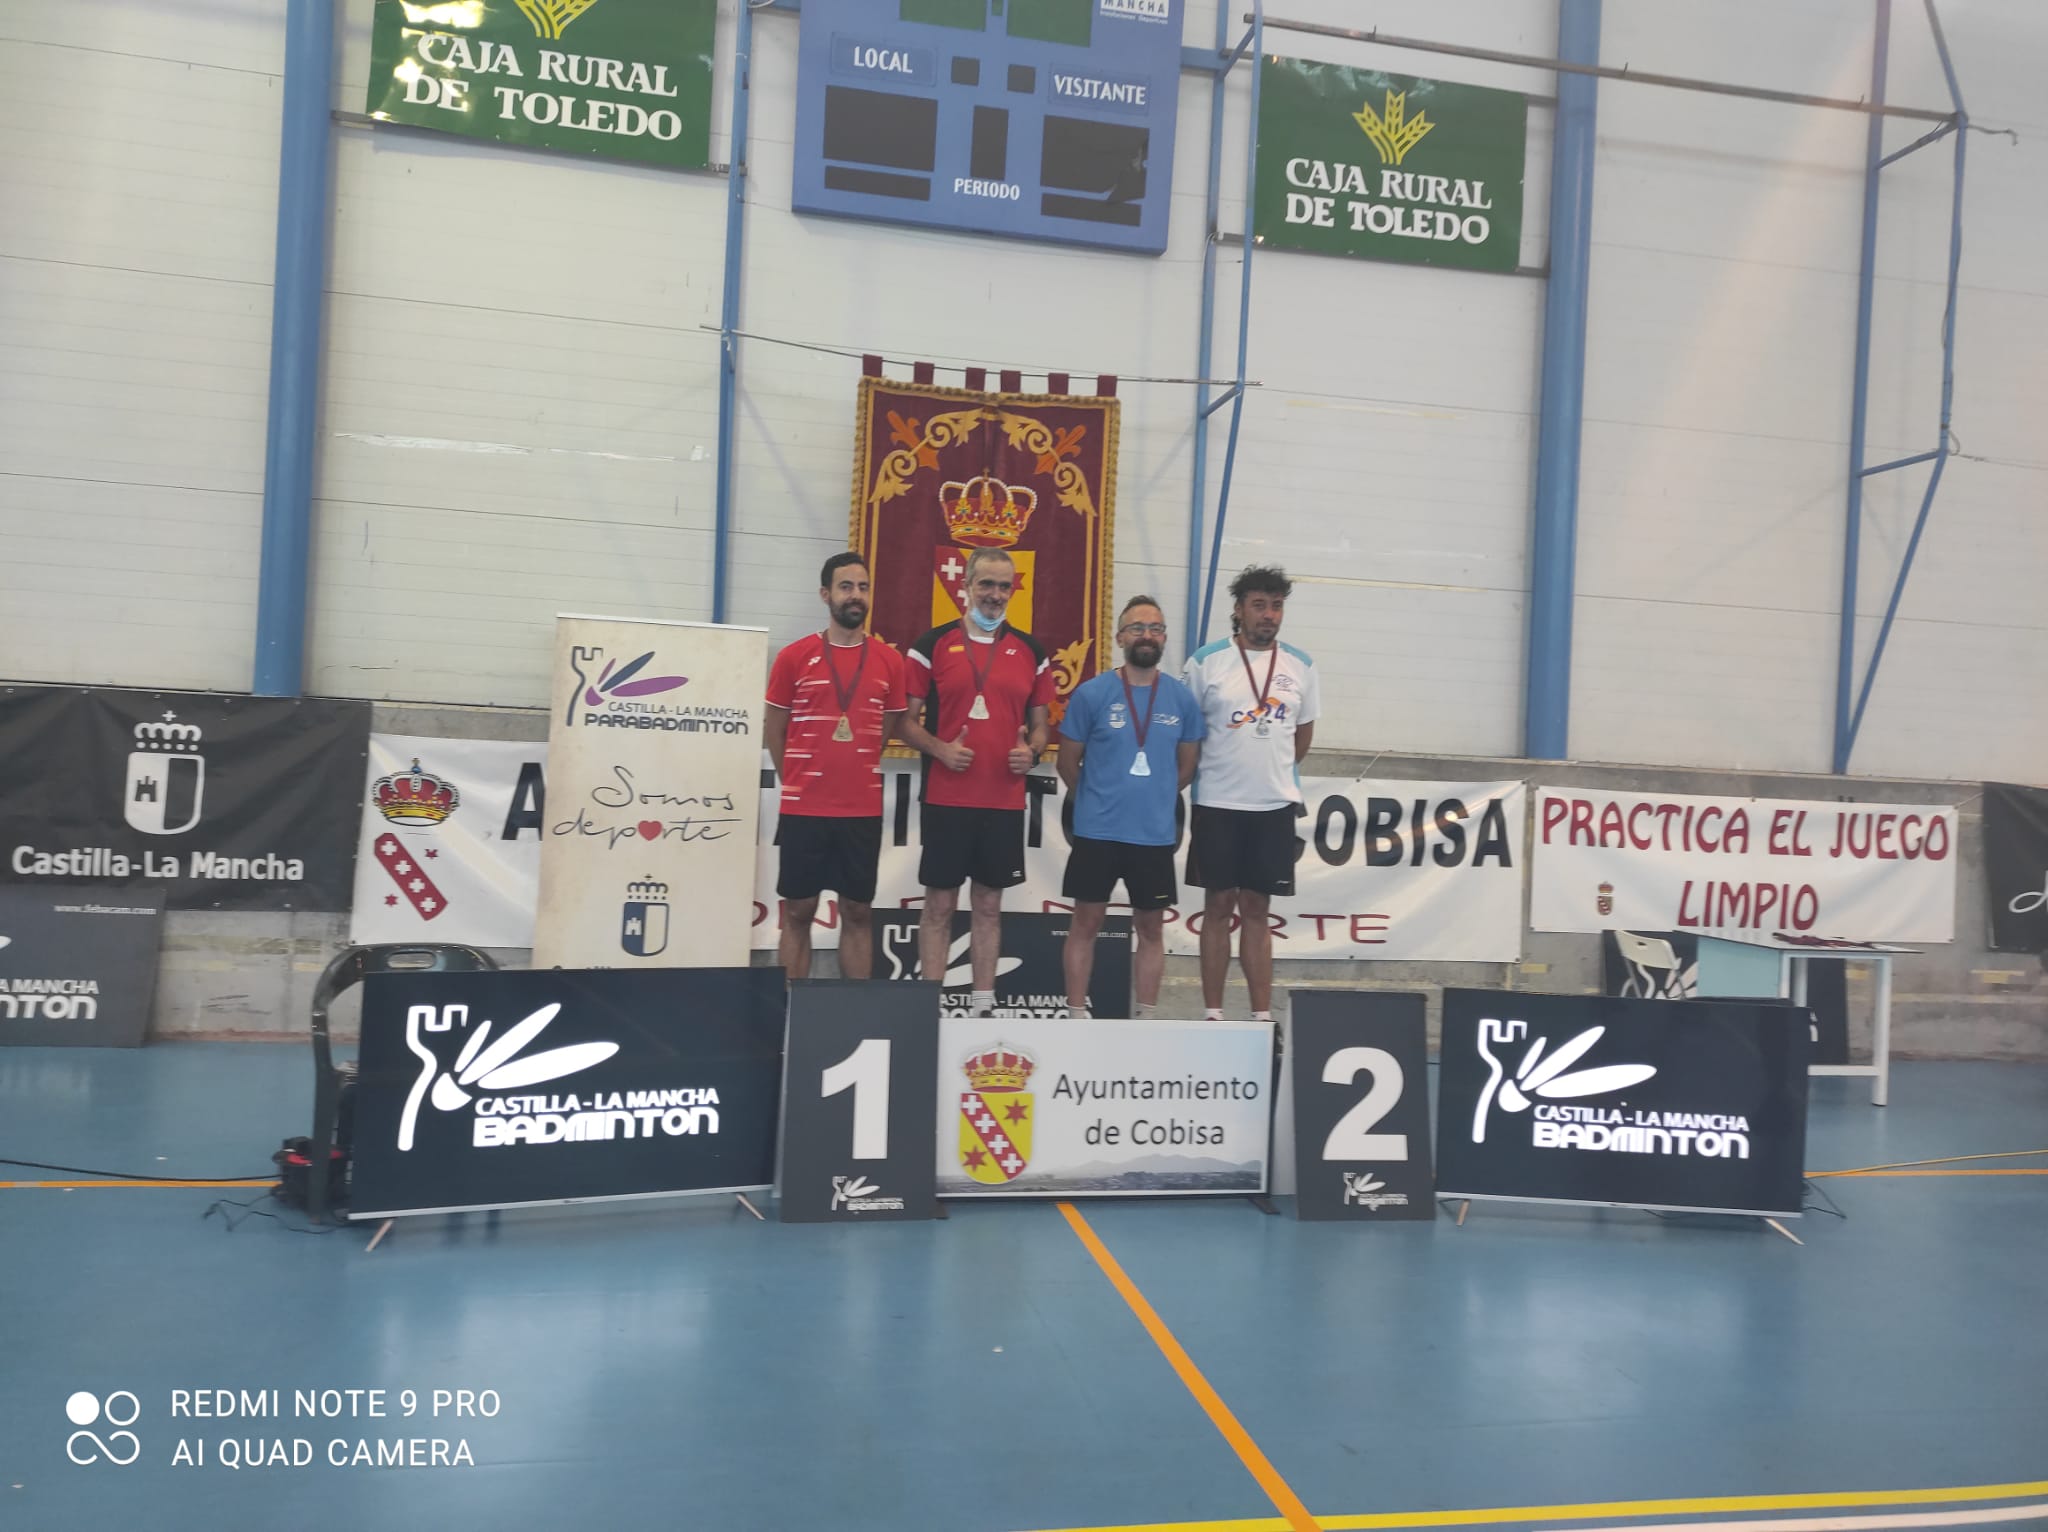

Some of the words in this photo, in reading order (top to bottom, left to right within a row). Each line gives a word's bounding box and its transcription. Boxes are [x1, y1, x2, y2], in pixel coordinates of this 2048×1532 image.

[418, 33, 523, 77] CAJA
[537, 50, 678, 97] RURAL
[854, 46, 913, 73] LOCAL
[403, 74, 469, 112] DE
[494, 87, 682, 141] TOLEDO
[1054, 75, 1146, 105] VISITANTE
[954, 178, 1020, 200] PERIODO
[1286, 157, 1369, 195] CAJA
[1379, 169, 1492, 210] RURAL
[1285, 193, 1335, 228] DE
[1347, 200, 1489, 244] TOLEDO
[584, 712, 749, 736] PARABADMINTON
[608, 701, 667, 715] CASTILLA
[676, 705, 692, 716] LA
[694, 706, 749, 719] MANCHA
[591, 765, 734, 811] Somos
[1542, 796, 1749, 854] PRACTICA
[1769, 808, 1813, 856] EL
[1829, 811, 1950, 862] JUEGO
[12, 845, 180, 878] Castilla-La
[190, 851, 304, 881] Mancha
[1677, 880, 1820, 930] LIMPIO
[11, 978, 100, 994] MANCHA
[1007, 994, 1026, 1007] LA
[474, 1094, 581, 1116] CASTILLA
[594, 1092, 624, 1110] LA
[626, 1088, 720, 1108] MANCHA
[821, 1038, 891, 1159] 1
[1052, 1073, 1259, 1106] Ayuntamiento
[1322, 1046, 1409, 1161] 2
[473, 1106, 720, 1147] BADMINTON
[1084, 1118, 1120, 1145] de
[1131, 1118, 1225, 1145] Cobisa
[1533, 1104, 1624, 1124] CASTILLA
[1635, 1110, 1661, 1126] LA
[1663, 1112, 1750, 1131] MANCHA
[1532, 1121, 1750, 1159] BADMINTON
